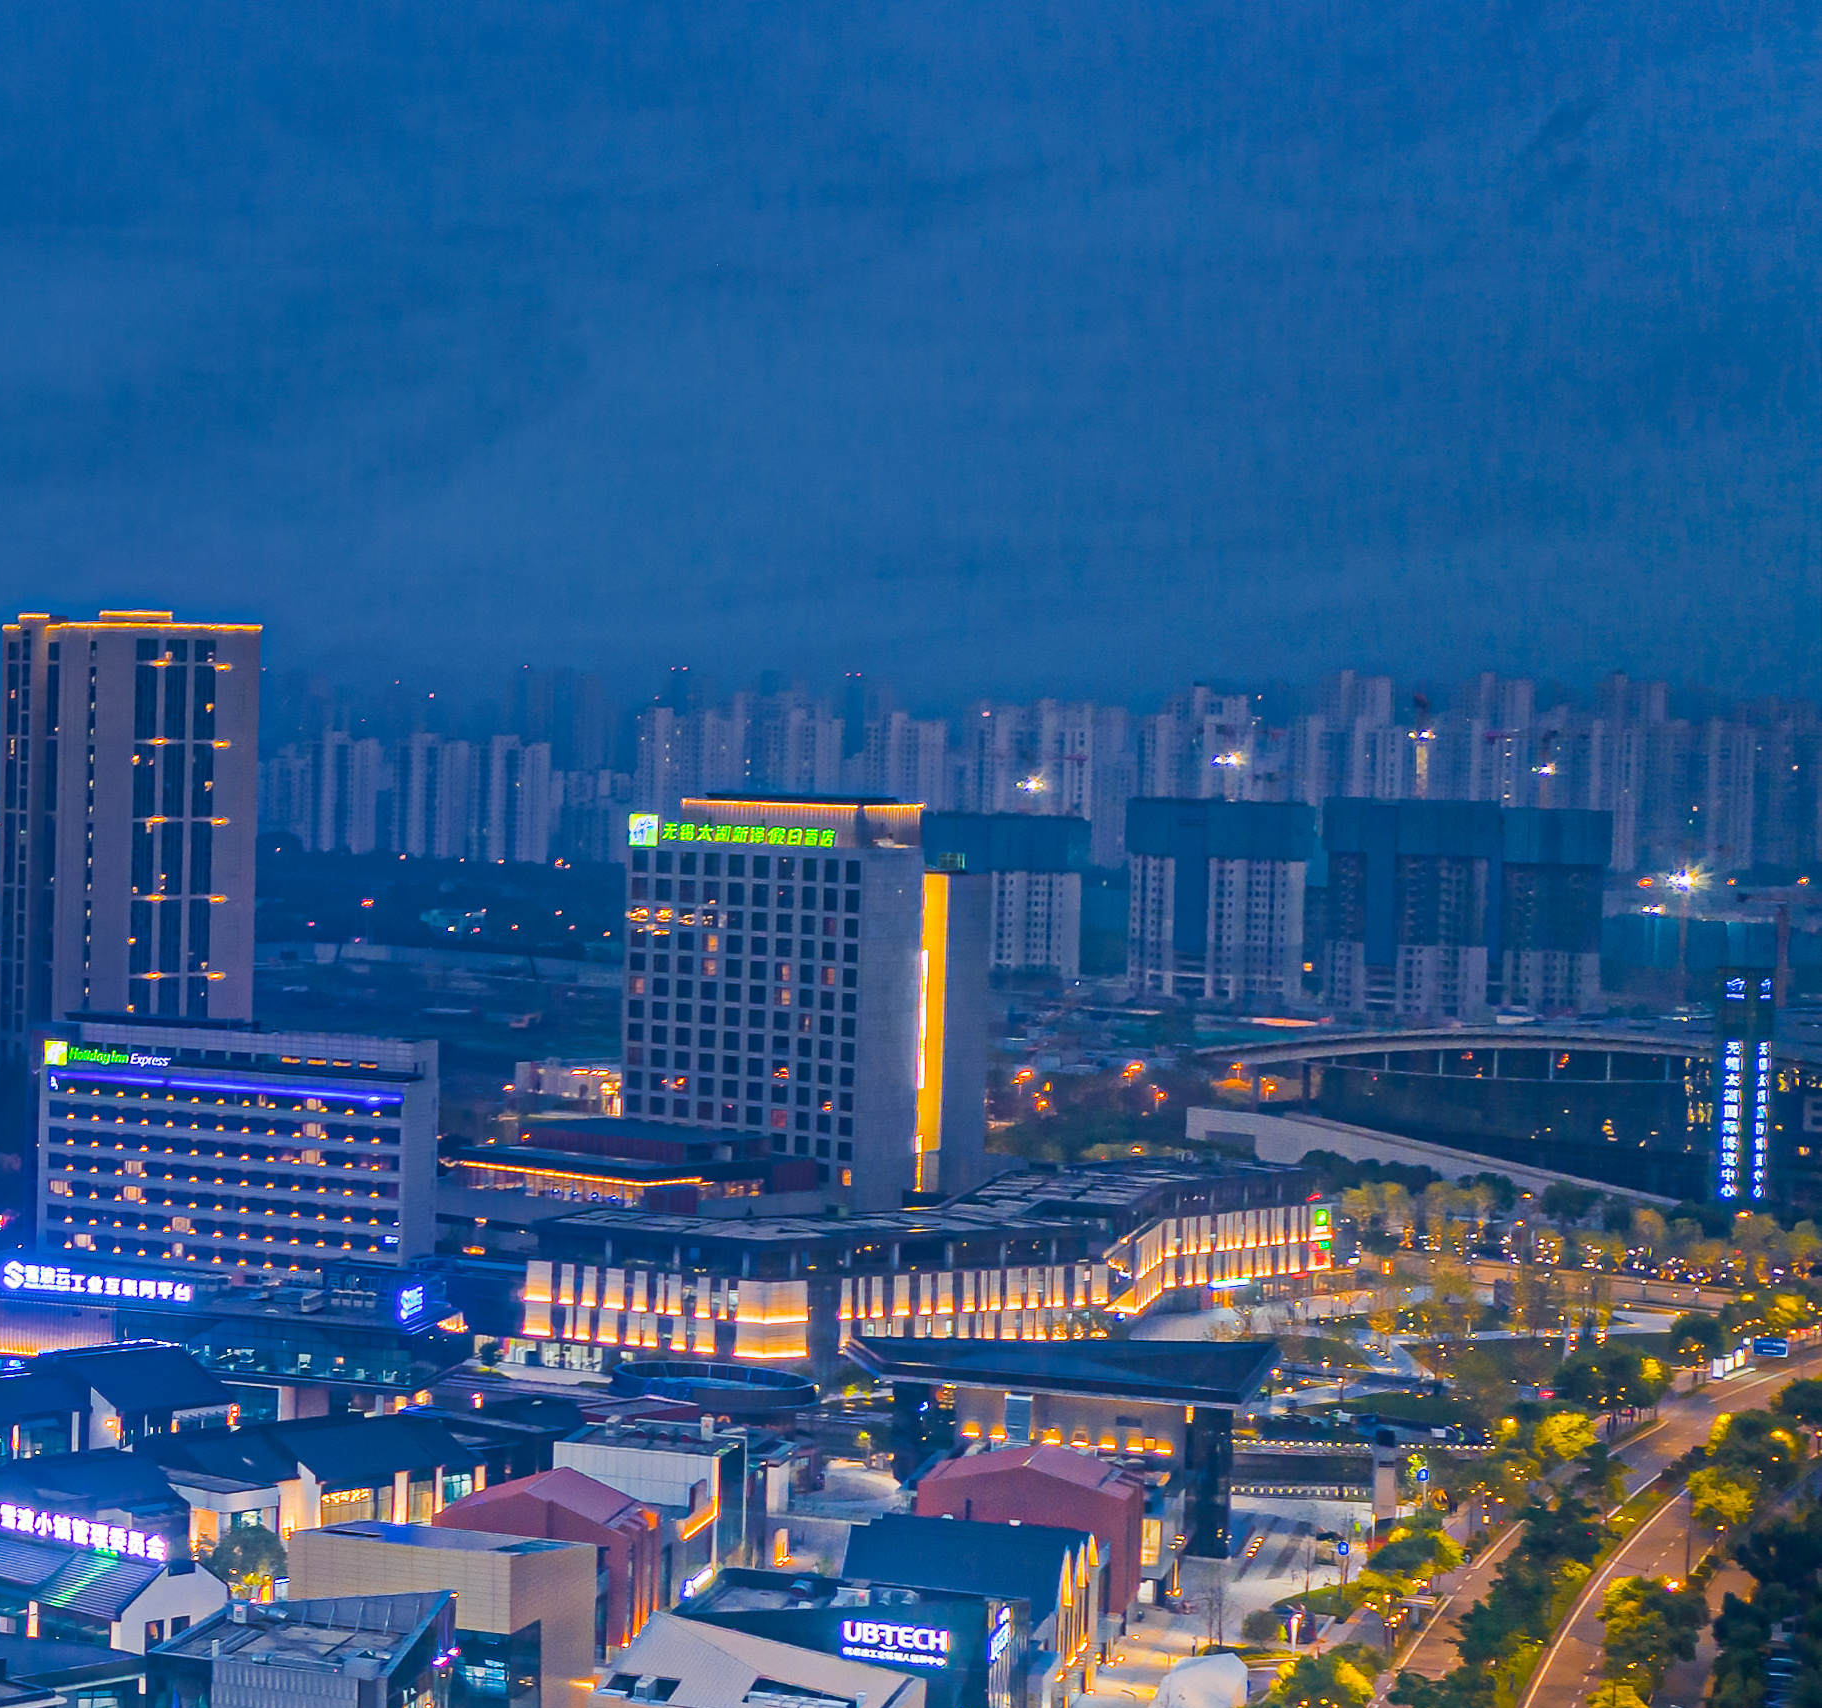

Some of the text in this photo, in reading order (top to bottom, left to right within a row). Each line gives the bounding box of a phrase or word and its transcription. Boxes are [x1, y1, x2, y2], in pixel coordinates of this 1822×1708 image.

[69, 1047, 172, 1067] Holiday Inn Express
